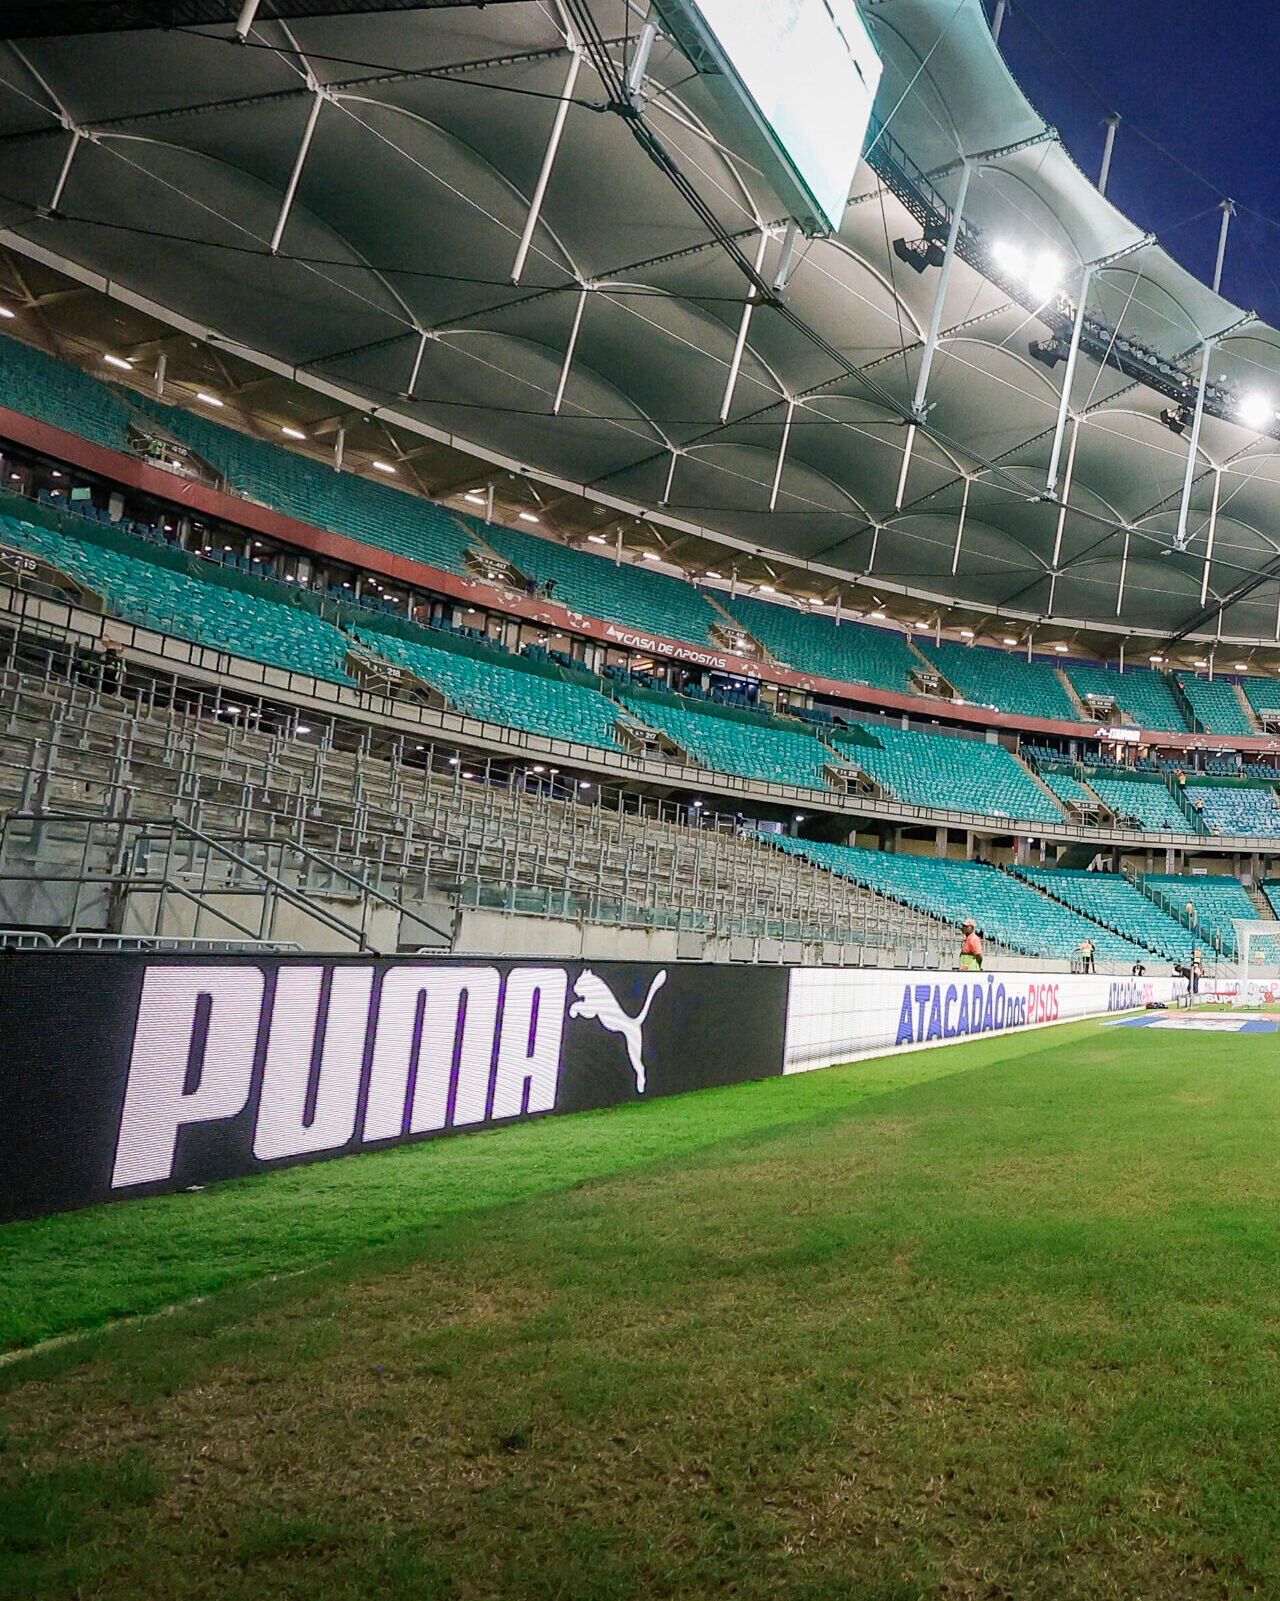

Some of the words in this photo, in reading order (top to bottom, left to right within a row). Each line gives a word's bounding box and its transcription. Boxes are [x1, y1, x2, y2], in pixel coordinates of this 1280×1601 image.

[623, 634, 656, 651] CASA
[657, 643, 674, 655] DE
[673, 648, 727, 668] APOSTAS
[896, 974, 1006, 1045] ATACADÃO
[1027, 984, 1059, 1024] PISOS
[110, 966, 568, 1189] PUMA
